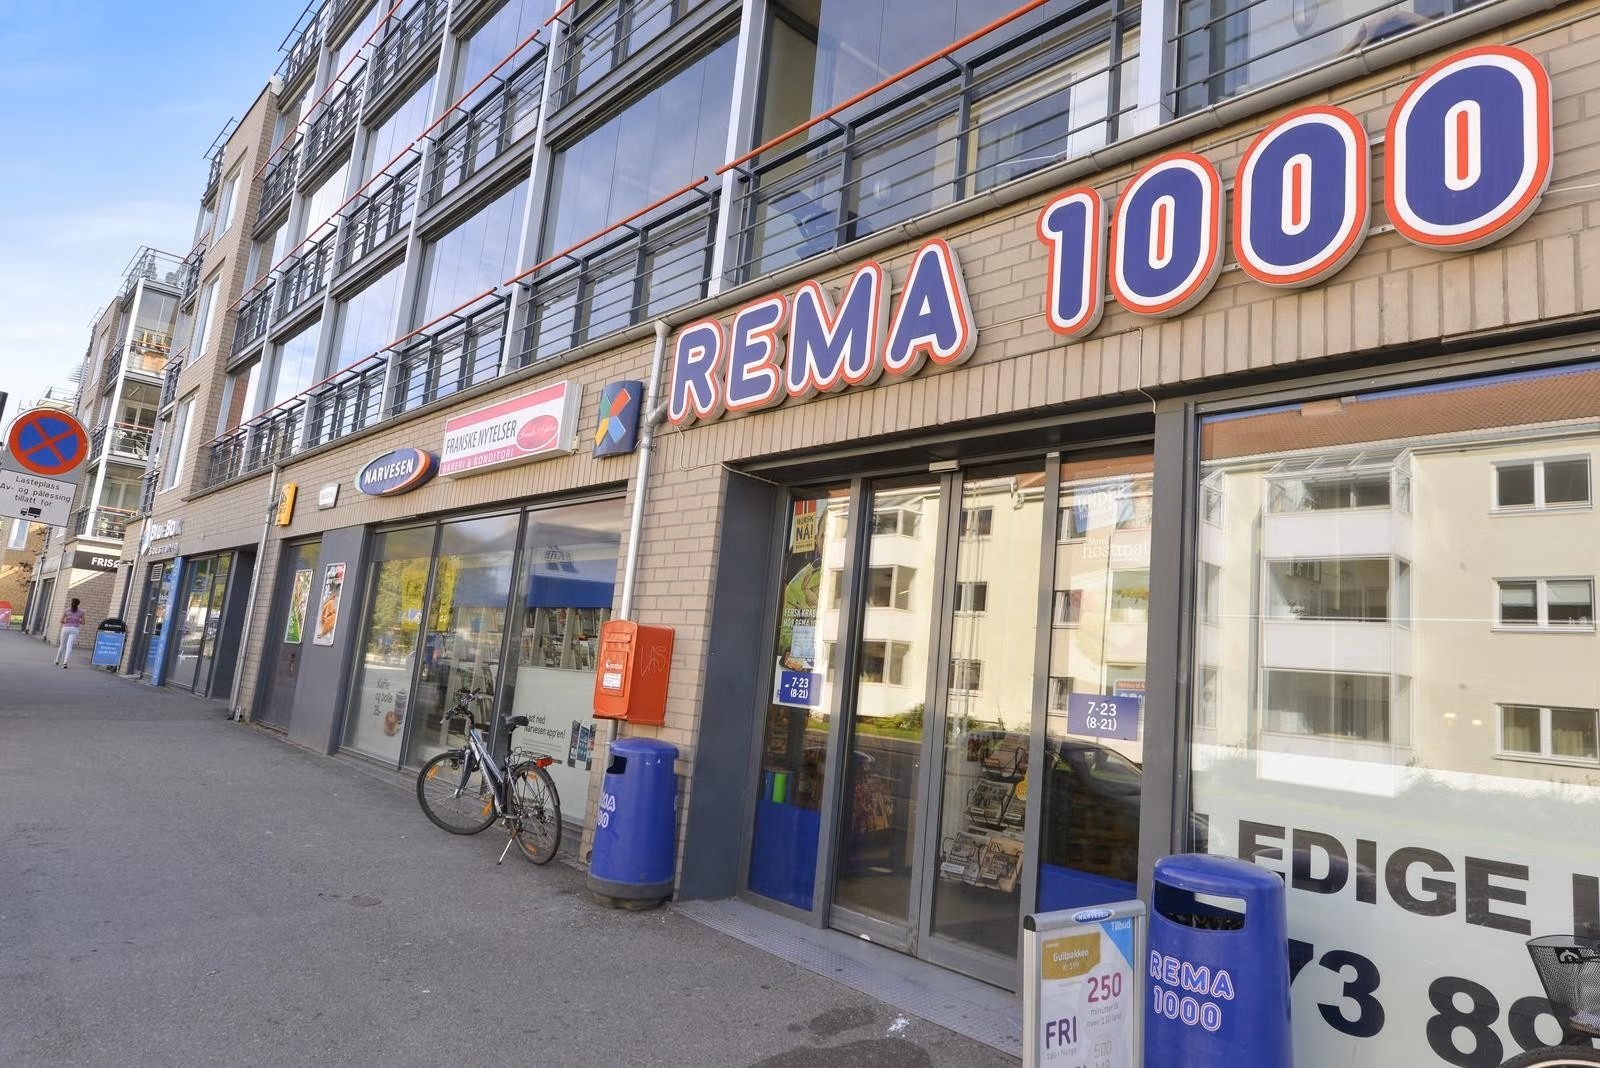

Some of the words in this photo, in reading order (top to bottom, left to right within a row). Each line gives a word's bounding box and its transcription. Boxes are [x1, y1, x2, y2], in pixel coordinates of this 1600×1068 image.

[667, 238, 977, 425] REMA
[1037, 44, 1554, 337] 1000
[446, 431, 479, 455] FRANSKE
[478, 420, 517, 447] NYTELSER
[473, 448, 514, 466] KONDITORI
[16, 475, 60, 490] Lasteplass
[364, 457, 414, 485] NARVESEN
[15, 494, 36, 504] tillatt
[40, 499, 52, 507] for
[18, 487, 29, 495] og
[1086, 716, 1117, 731] (8-21)
[1110, 919, 1131, 931] Tilbud
[1053, 949, 1089, 962] Gullpakken
[1150, 949, 1235, 1001] REMA
[1087, 972, 1122, 1003] 250
[1153, 985, 1222, 1032] 1000
[1045, 1016, 1077, 1050] FRI
